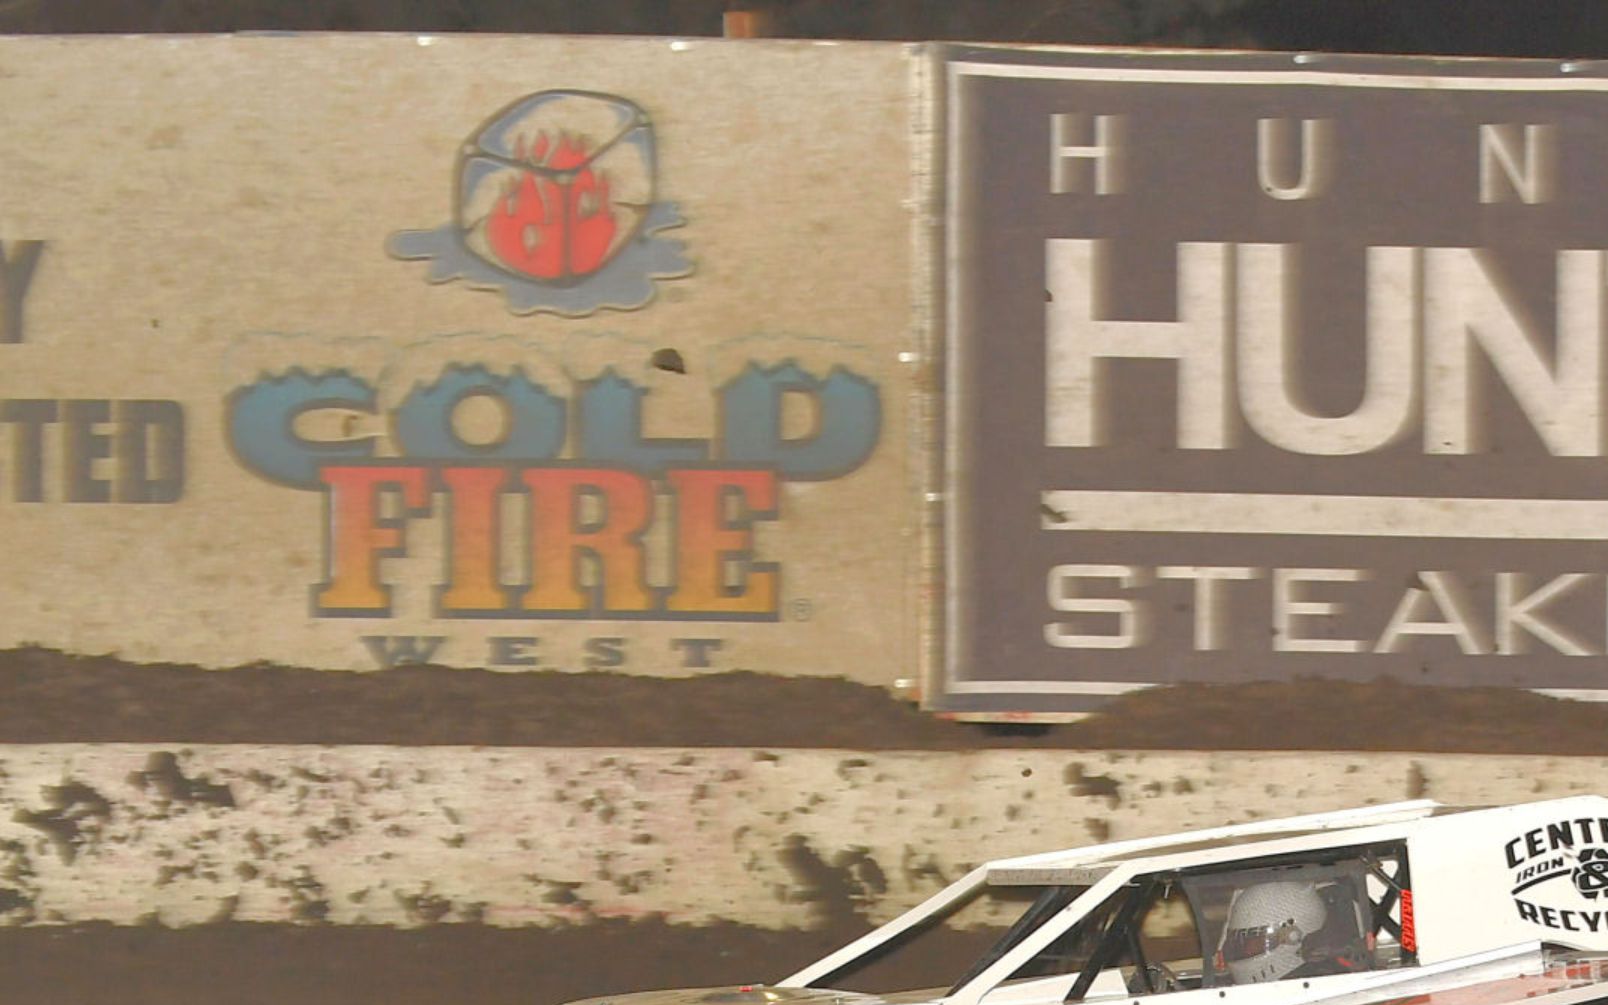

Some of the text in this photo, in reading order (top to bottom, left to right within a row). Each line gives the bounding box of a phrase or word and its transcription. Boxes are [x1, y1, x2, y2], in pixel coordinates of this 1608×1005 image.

[224, 352, 884, 490] COLD
[309, 462, 782, 622] FIRE
[362, 636, 726, 669] WEST
[1516, 857, 1565, 884] IRON
